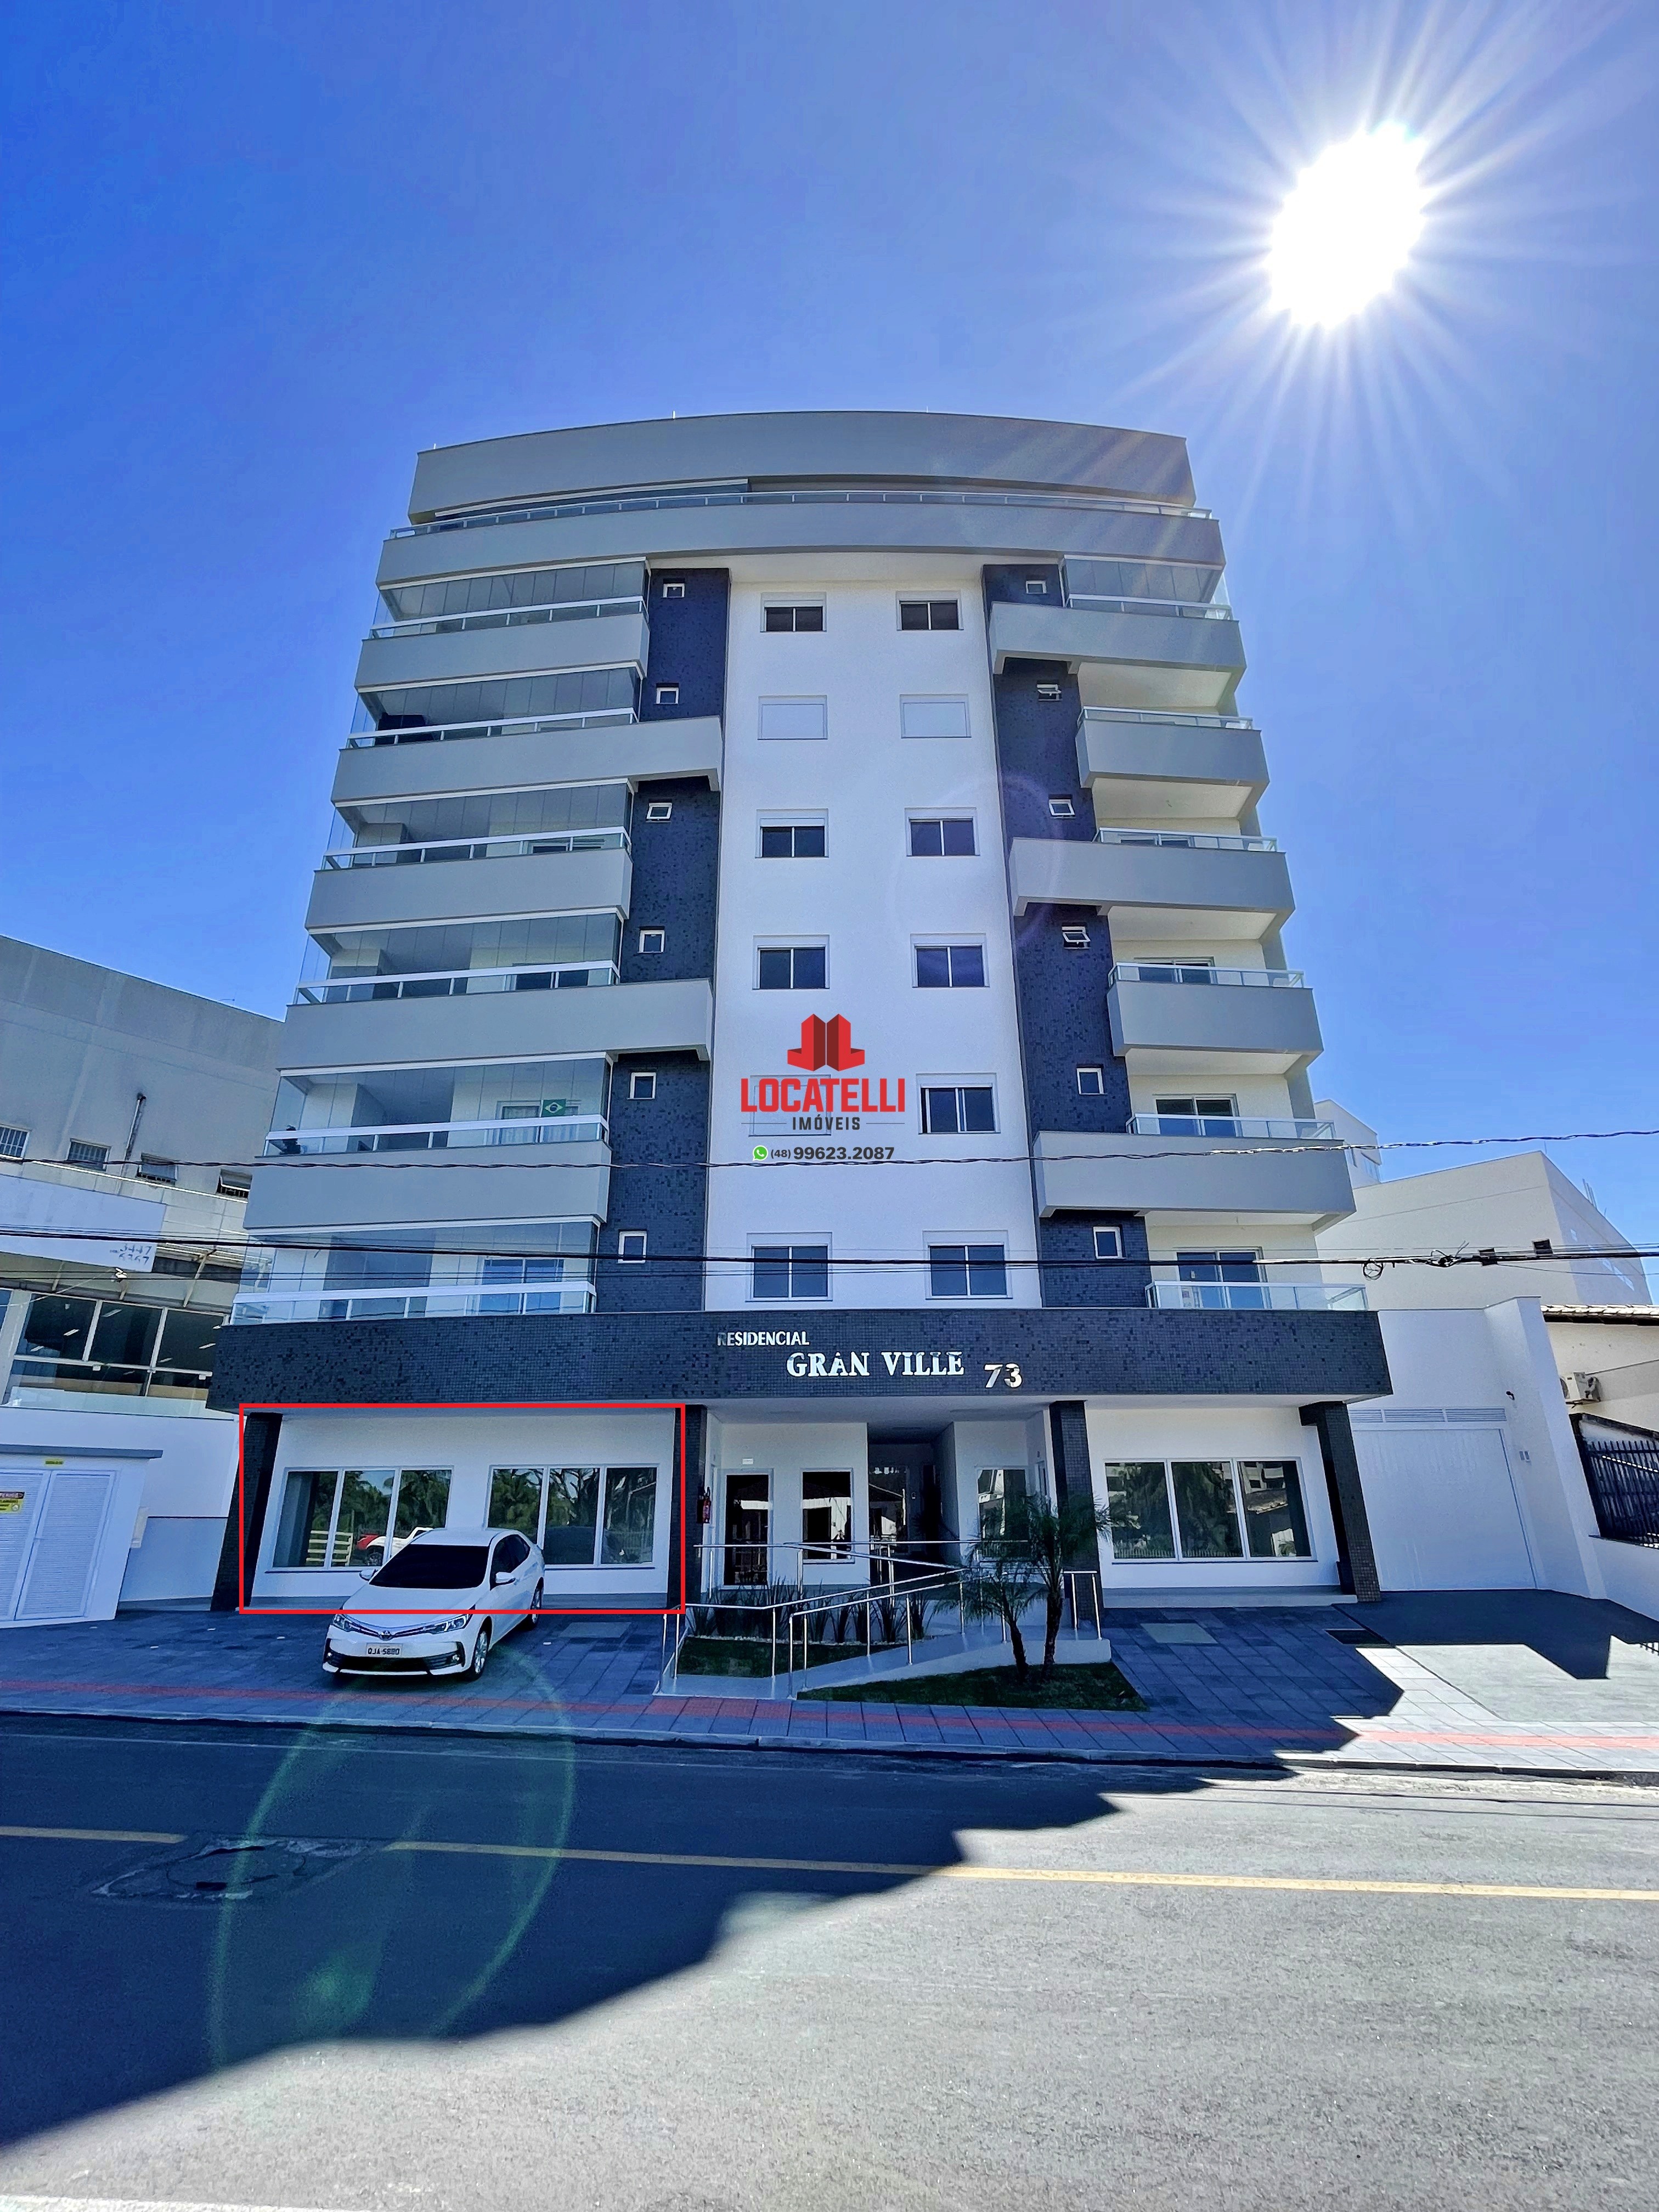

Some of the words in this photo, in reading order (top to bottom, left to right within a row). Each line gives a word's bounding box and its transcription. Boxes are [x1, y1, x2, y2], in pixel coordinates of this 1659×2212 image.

[717, 1331, 810, 1346] RESIDENCIAL
[786, 1352, 870, 1377] GRAN
[881, 1351, 964, 1376] VILLE
[984, 1363, 1023, 1389] 73
